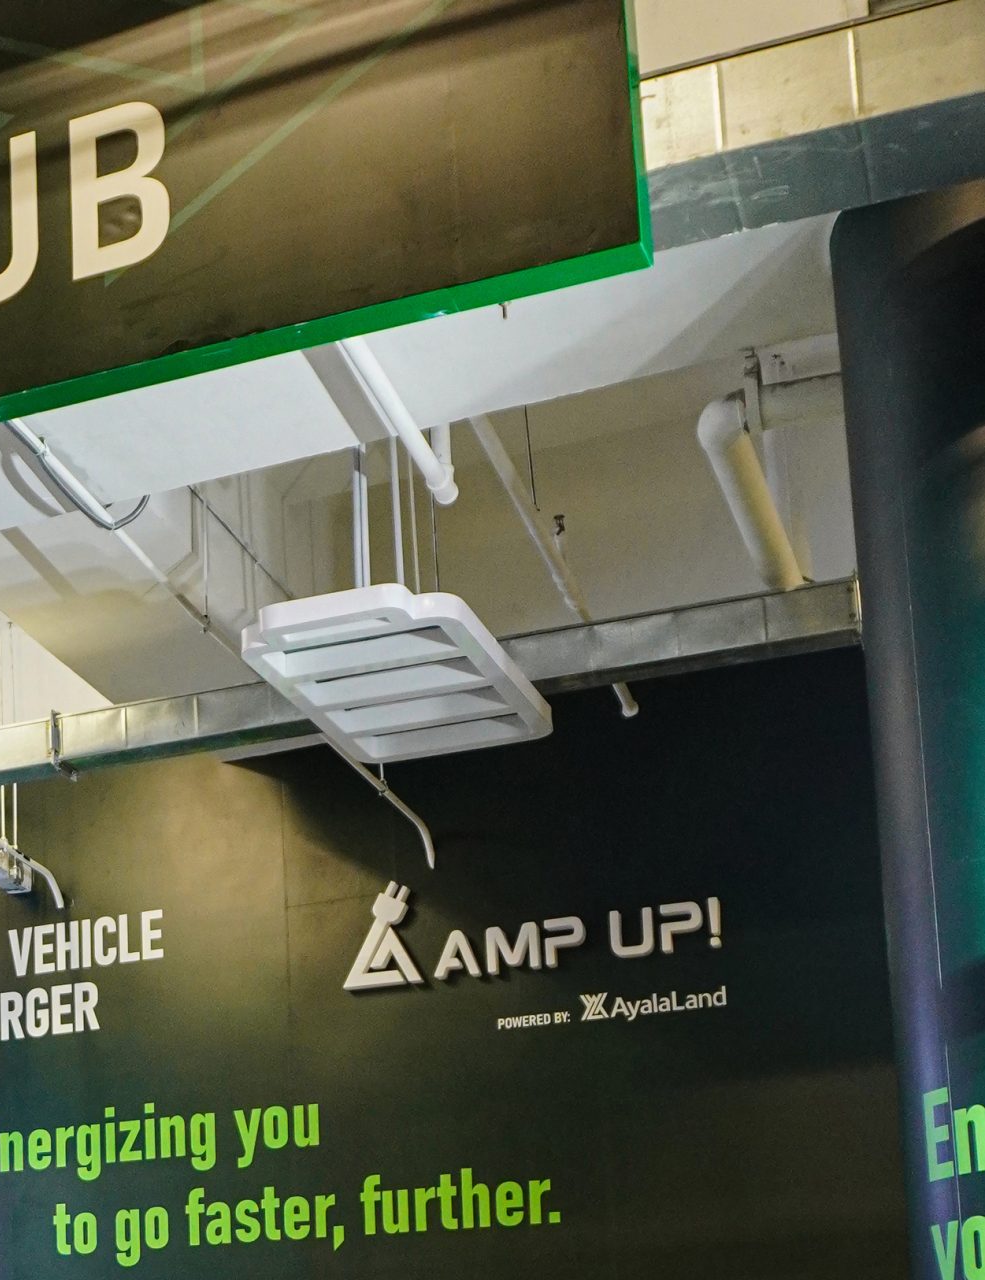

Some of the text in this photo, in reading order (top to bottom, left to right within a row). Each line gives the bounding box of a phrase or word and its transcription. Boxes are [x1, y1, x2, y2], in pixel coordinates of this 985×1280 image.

[8, 909, 164, 977] VEHICLE
[434, 897, 723, 980] AMP UP!
[497, 1011, 571, 1029] POWERED BY:
[610, 986, 727, 1020] AyalaLand
[234, 1104, 320, 1168] you
[53, 1168, 561, 1267] to go faster, further.
